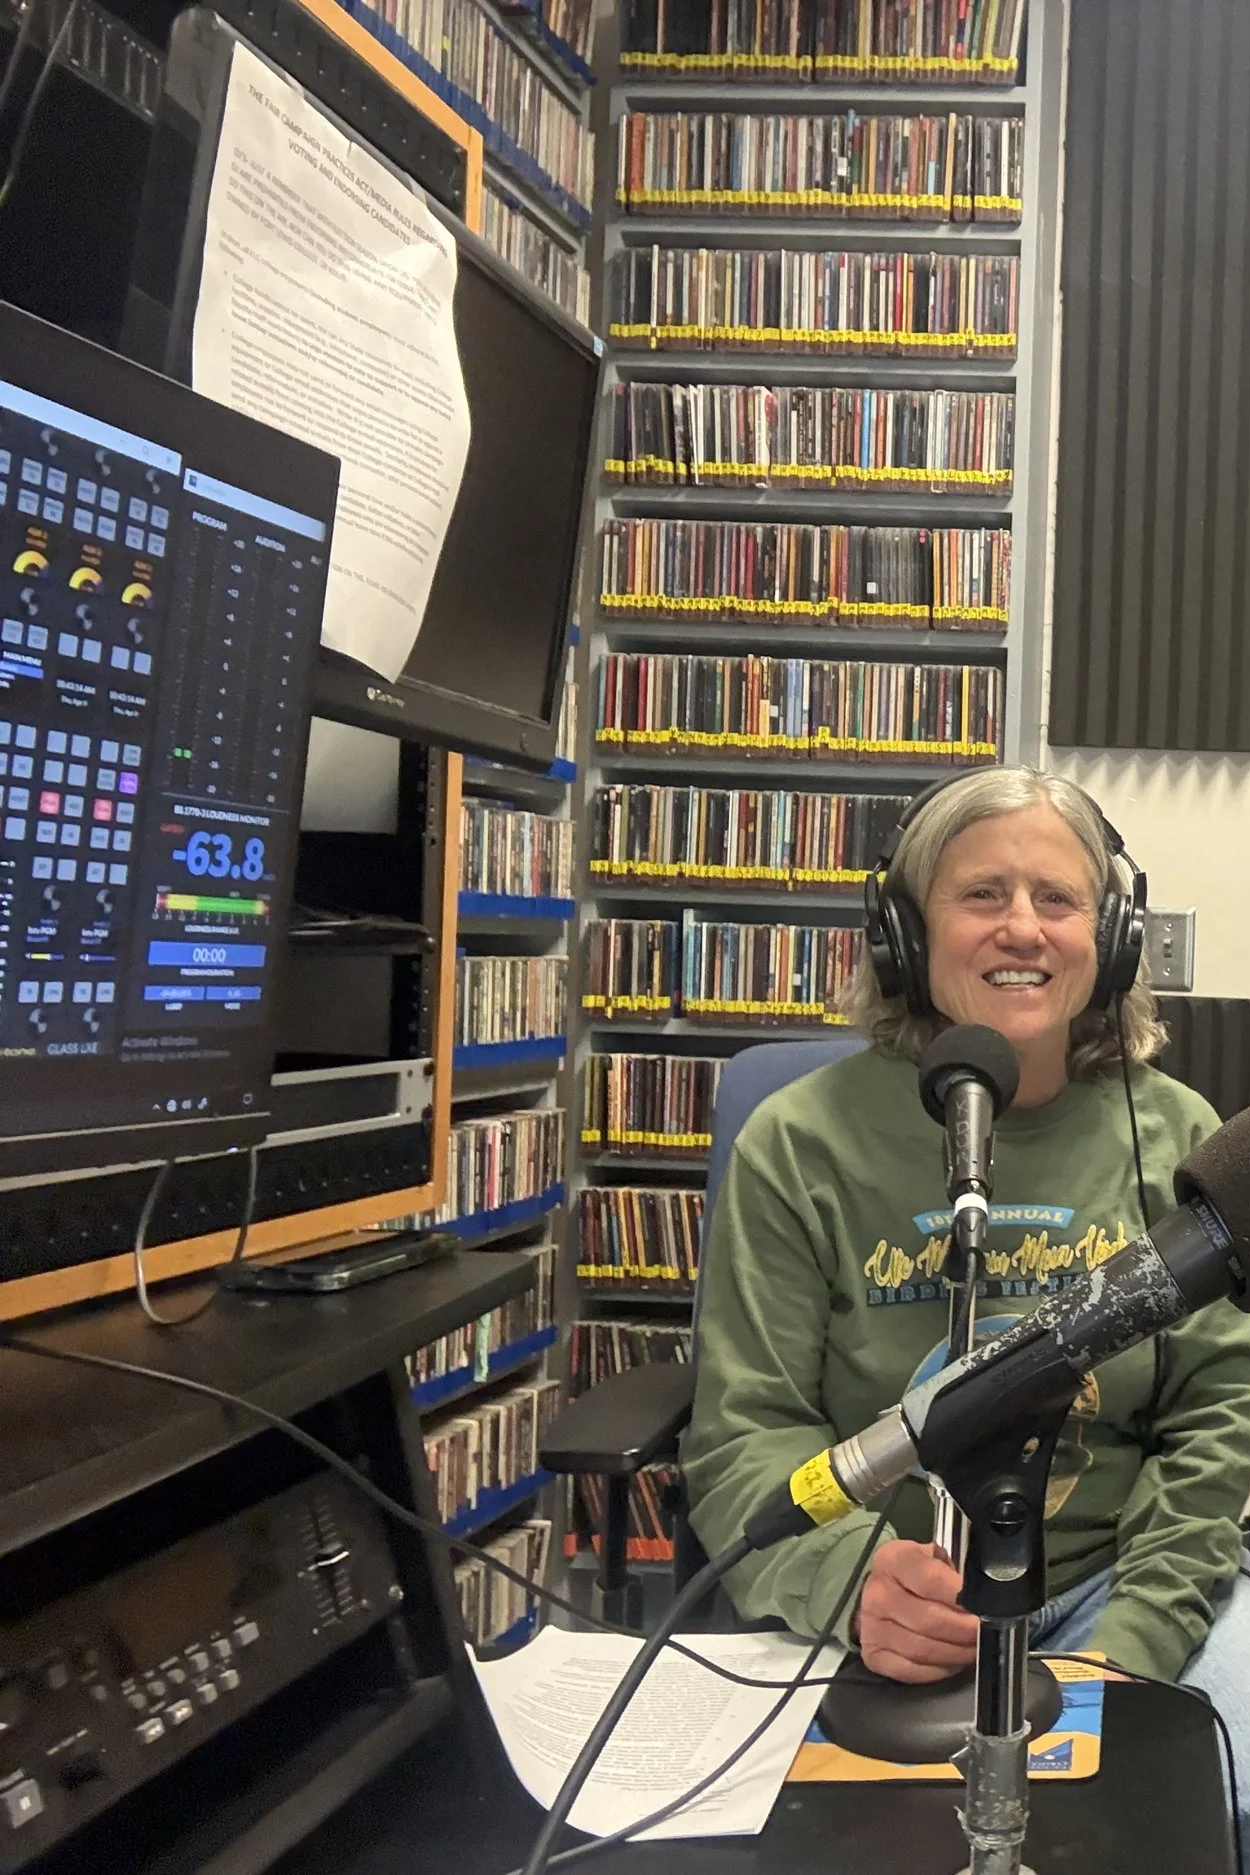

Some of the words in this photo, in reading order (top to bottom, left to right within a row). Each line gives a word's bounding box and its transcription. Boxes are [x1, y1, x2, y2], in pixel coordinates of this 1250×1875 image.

[248, 84, 263, 105] THE
[281, 113, 321, 153] CAMPAIGN
[322, 145, 355, 182] PRACTICES
[392, 206, 412, 230] RULES
[288, 137, 317, 169] VOTING
[318, 163, 333, 182] AND
[333, 175, 370, 215] ENDORSING
[370, 206, 412, 246] CANDIDATES
[192, 511, 228, 532] PROGRAM
[206, 809, 240, 822] LOUDNESS
[240, 814, 270, 827] MONITOR
[172, 831, 265, 881] -63.8
[192, 947, 226, 963] 00:00
[46, 1043, 79, 1056] GLASS
[991, 1208, 1064, 1224] NNUAL
